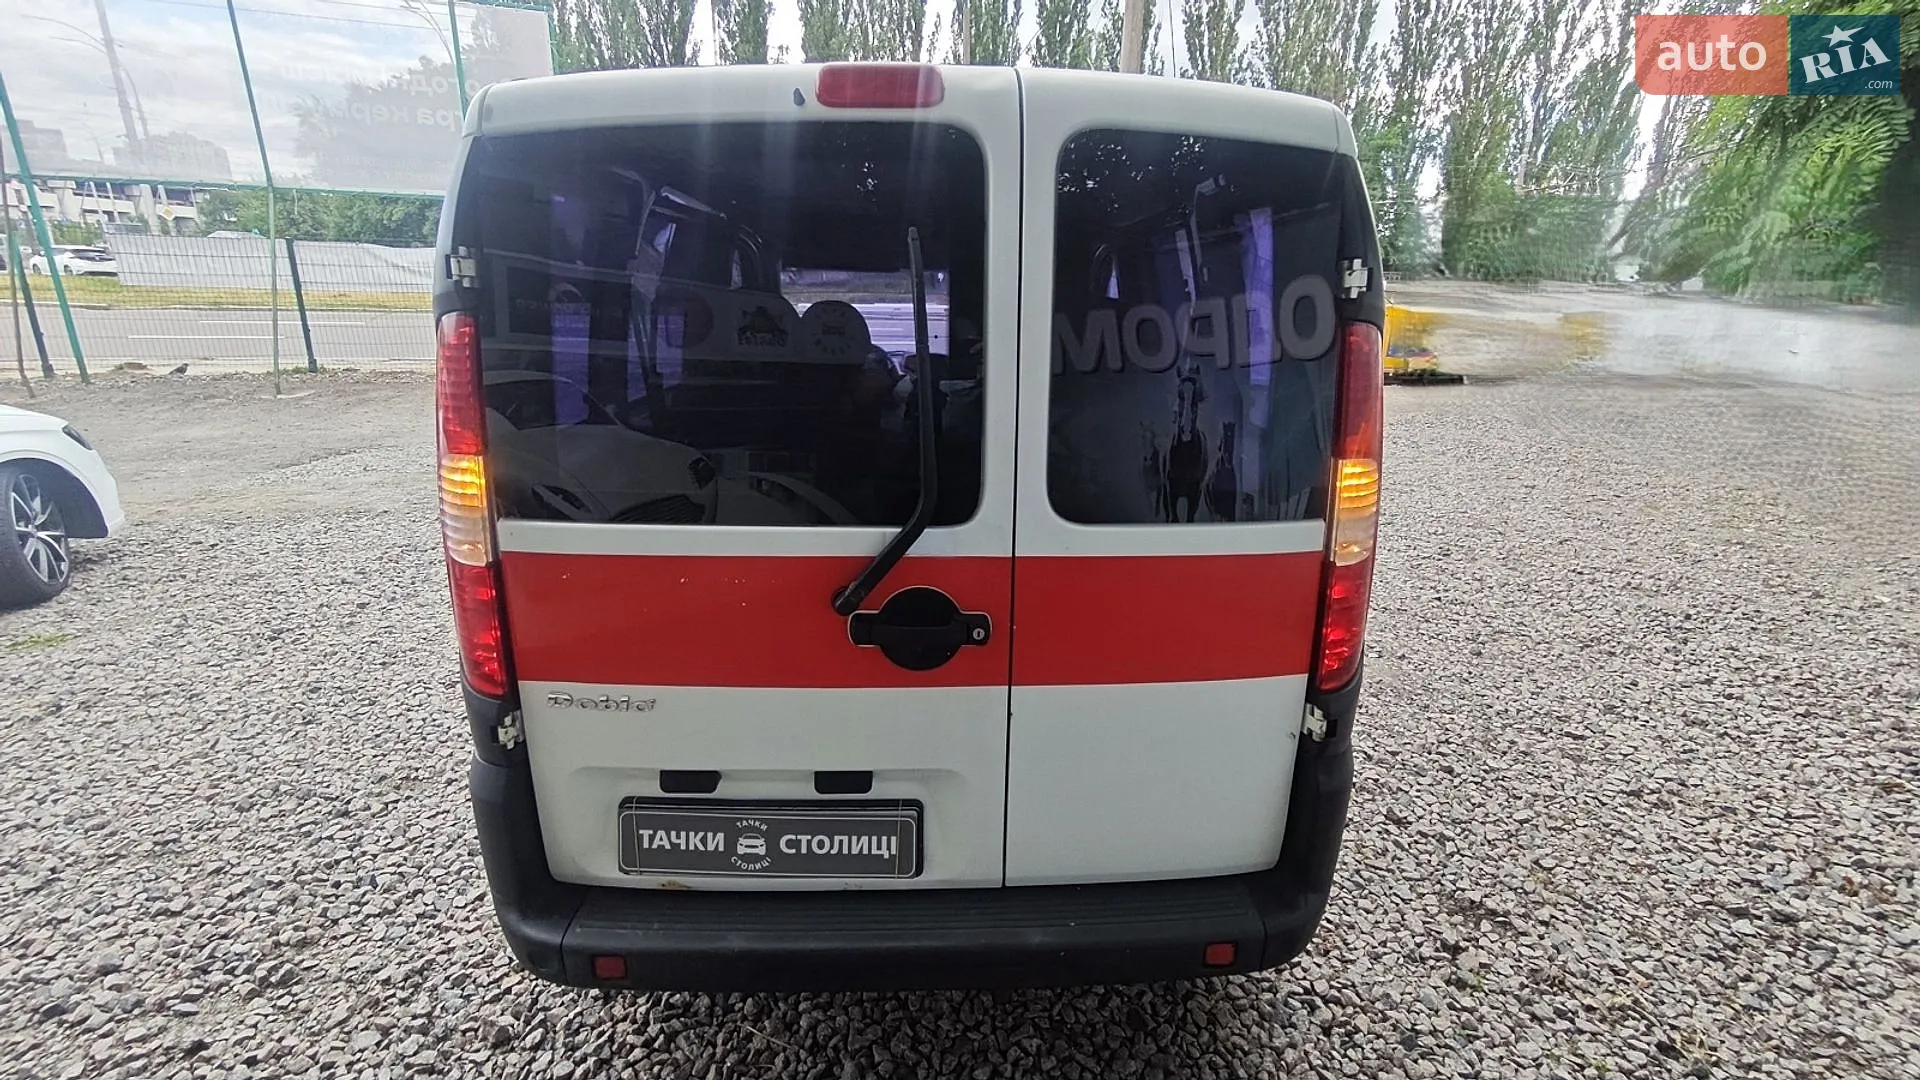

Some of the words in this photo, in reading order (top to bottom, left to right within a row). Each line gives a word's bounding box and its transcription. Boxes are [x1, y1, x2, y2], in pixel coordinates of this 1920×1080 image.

[736, 819, 768, 831] ТАЧКИ
[639, 829, 725, 851] ТАЧКИ
[779, 834, 897, 859] СТОЛИЦІ
[731, 856, 772, 871] СТОЛИЦІ
